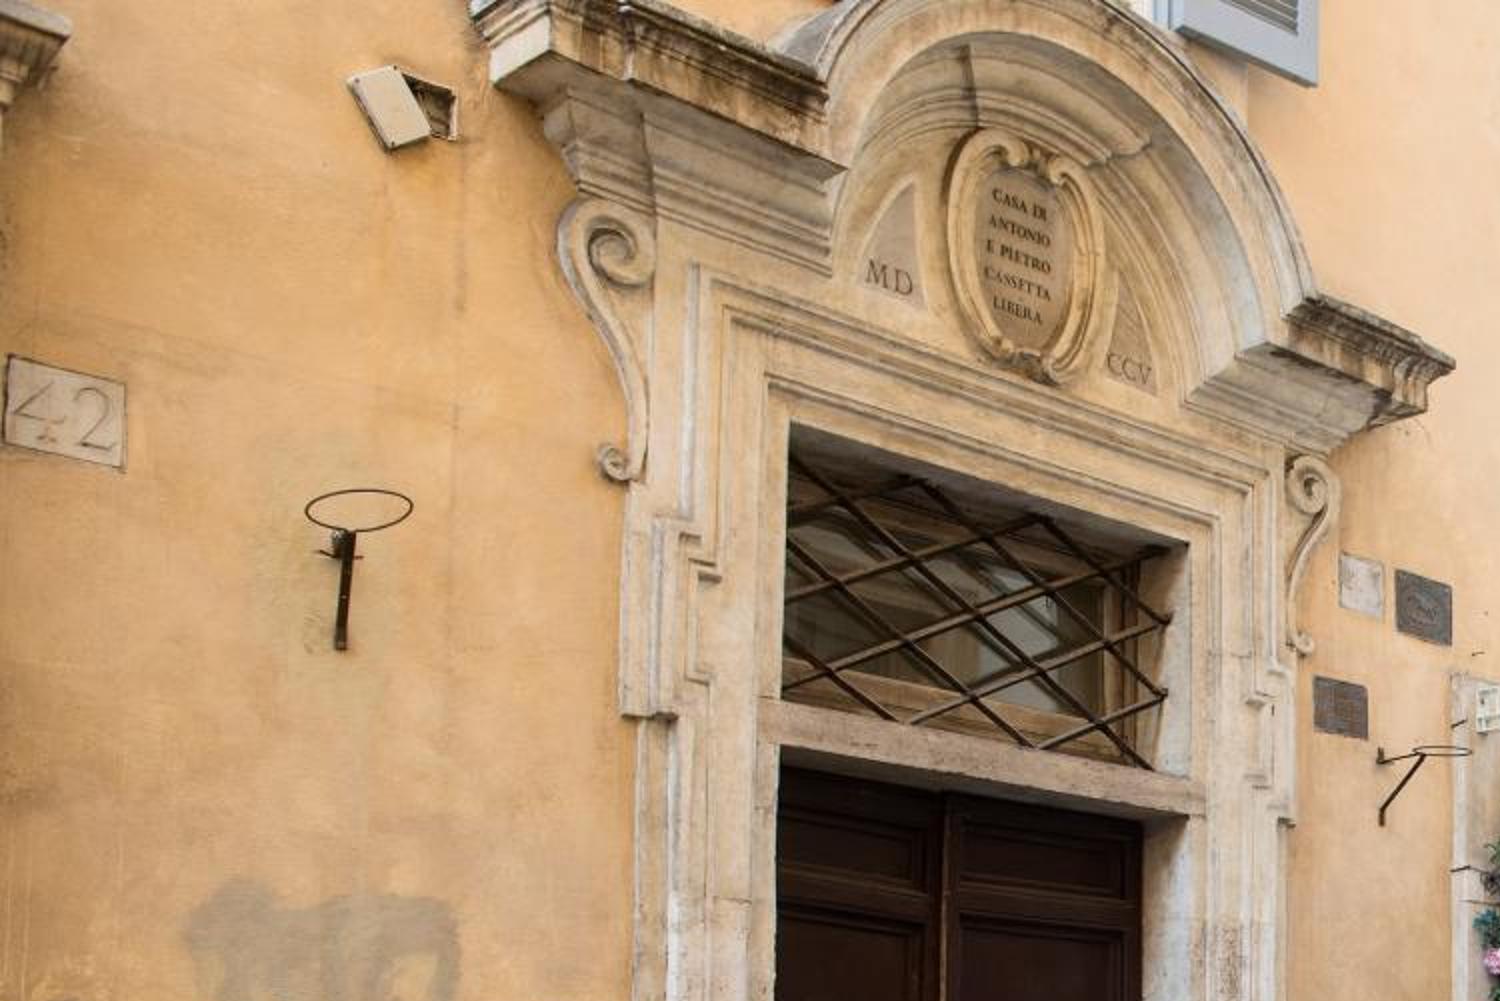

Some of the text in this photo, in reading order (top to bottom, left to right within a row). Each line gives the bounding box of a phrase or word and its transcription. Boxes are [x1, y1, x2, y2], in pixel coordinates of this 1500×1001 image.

[991, 187, 1048, 222] CASA DI
[988, 214, 1051, 248] ANTONIO
[1000, 244, 1052, 274] PIETRO
[984, 266, 1052, 301] CASSETTA
[992, 295, 1043, 325] LIBERA
[12, 379, 119, 453] 42
